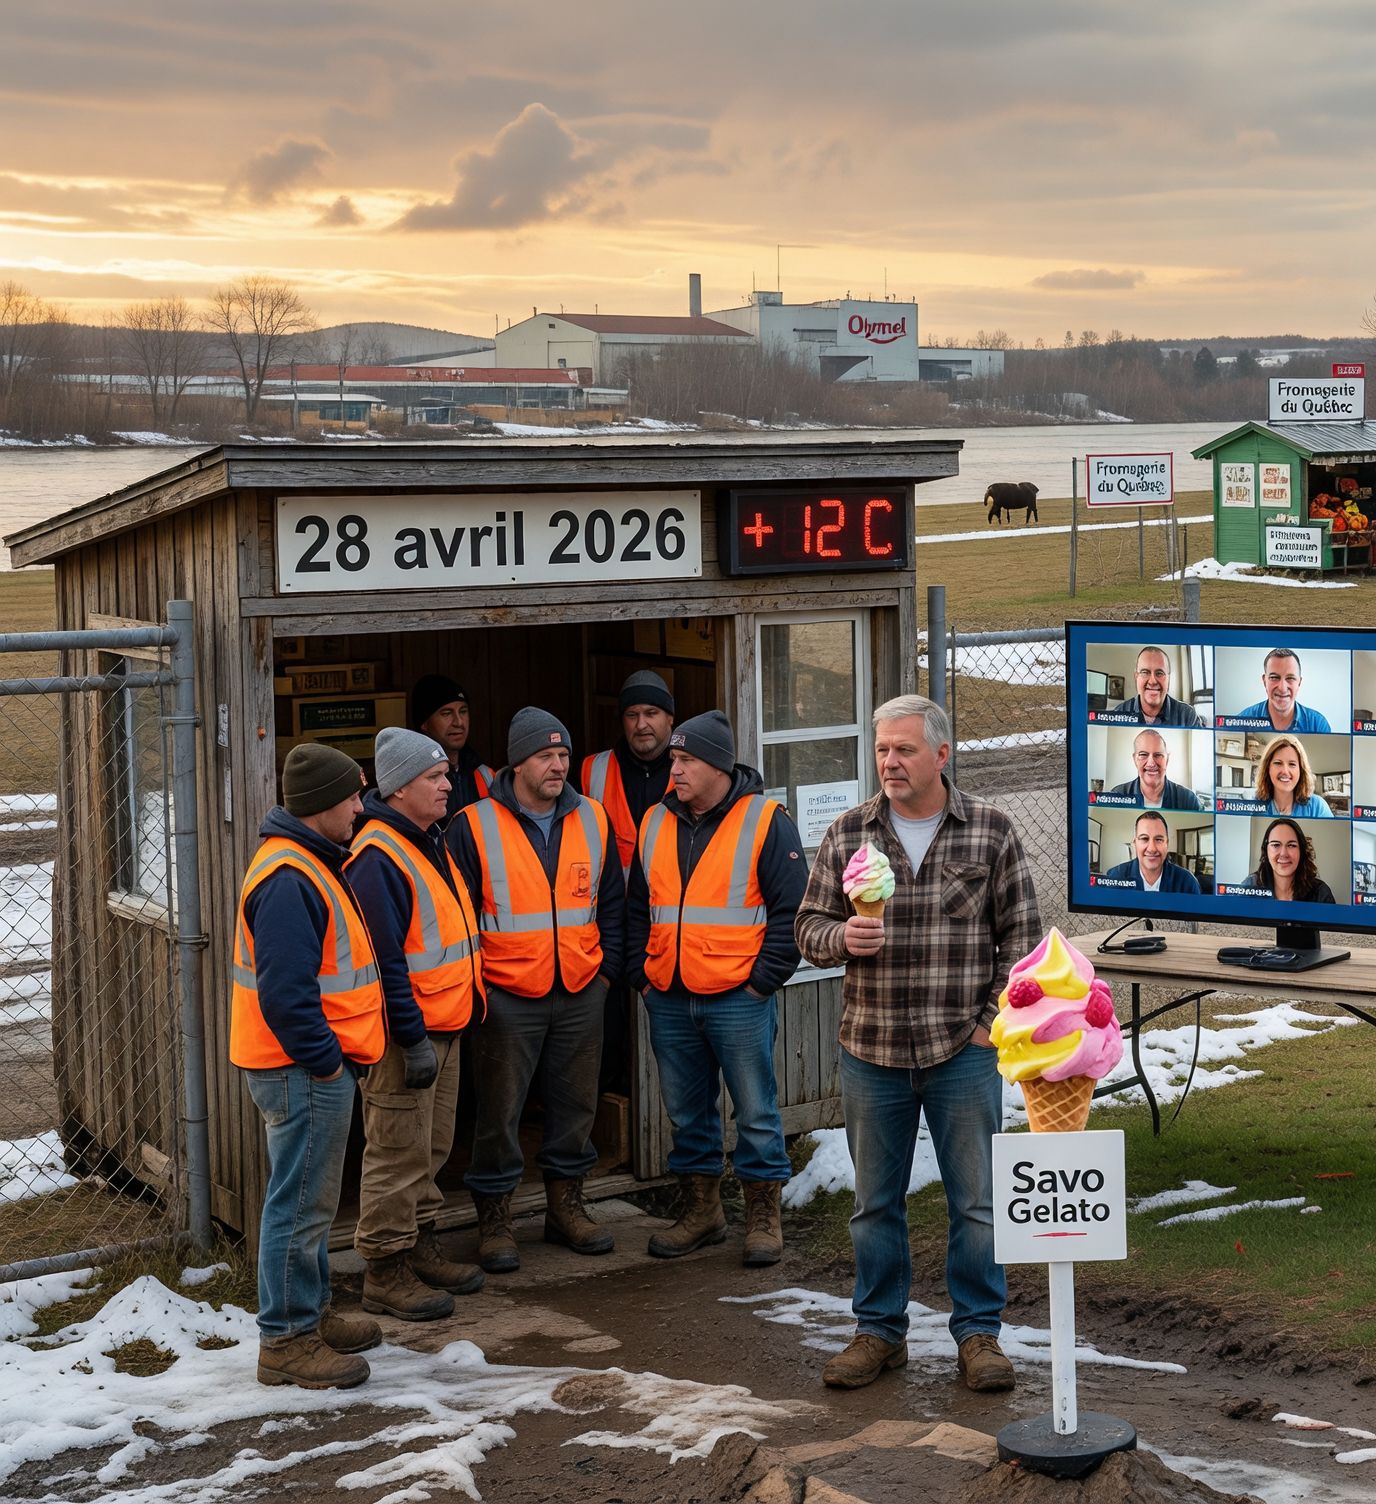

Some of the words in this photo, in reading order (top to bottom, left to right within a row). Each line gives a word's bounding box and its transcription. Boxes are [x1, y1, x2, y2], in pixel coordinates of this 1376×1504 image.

[295, 514, 371, 573] 28
[393, 511, 525, 570] avril
[548, 508, 686, 564] 2026
[1012, 1161, 1105, 1194] Savo
[1007, 1196, 1111, 1224] Gelato
